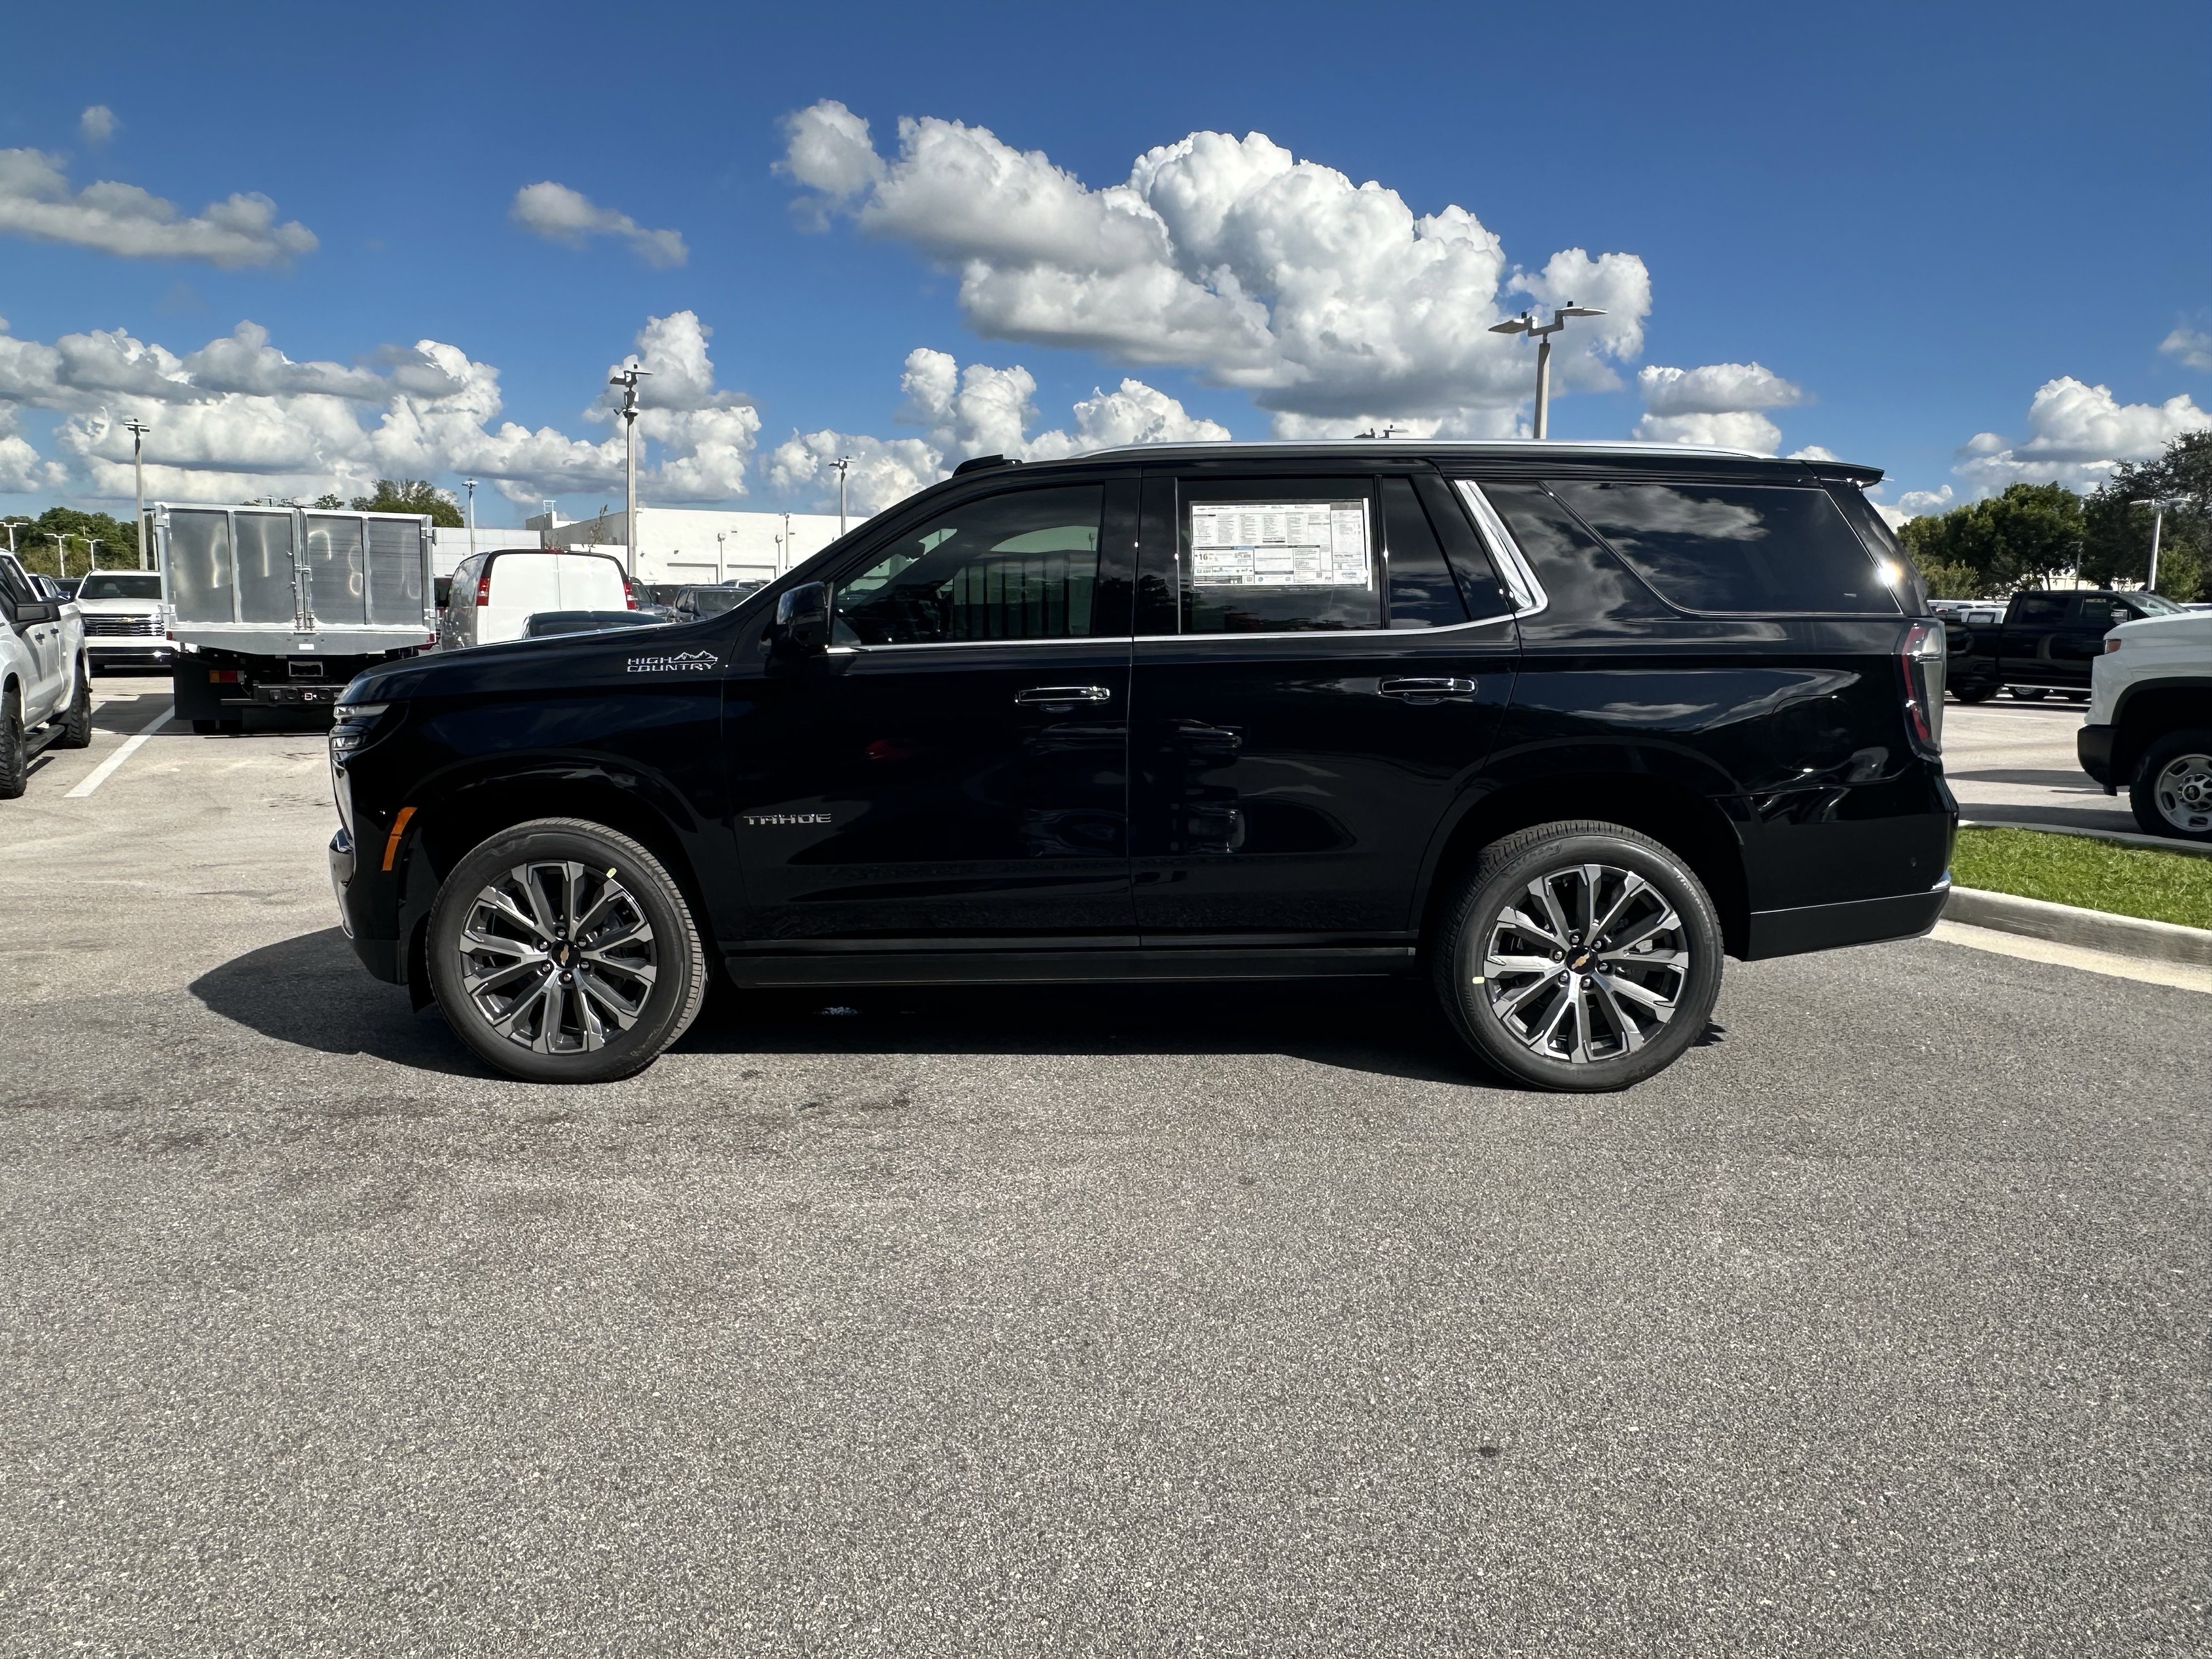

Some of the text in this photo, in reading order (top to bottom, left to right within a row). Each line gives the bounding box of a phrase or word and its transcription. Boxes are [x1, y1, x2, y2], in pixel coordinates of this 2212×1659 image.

[627, 657, 672, 665] HIGH
[627, 662, 716, 672] COUNTRY
[743, 814, 832, 825] TAHOE
